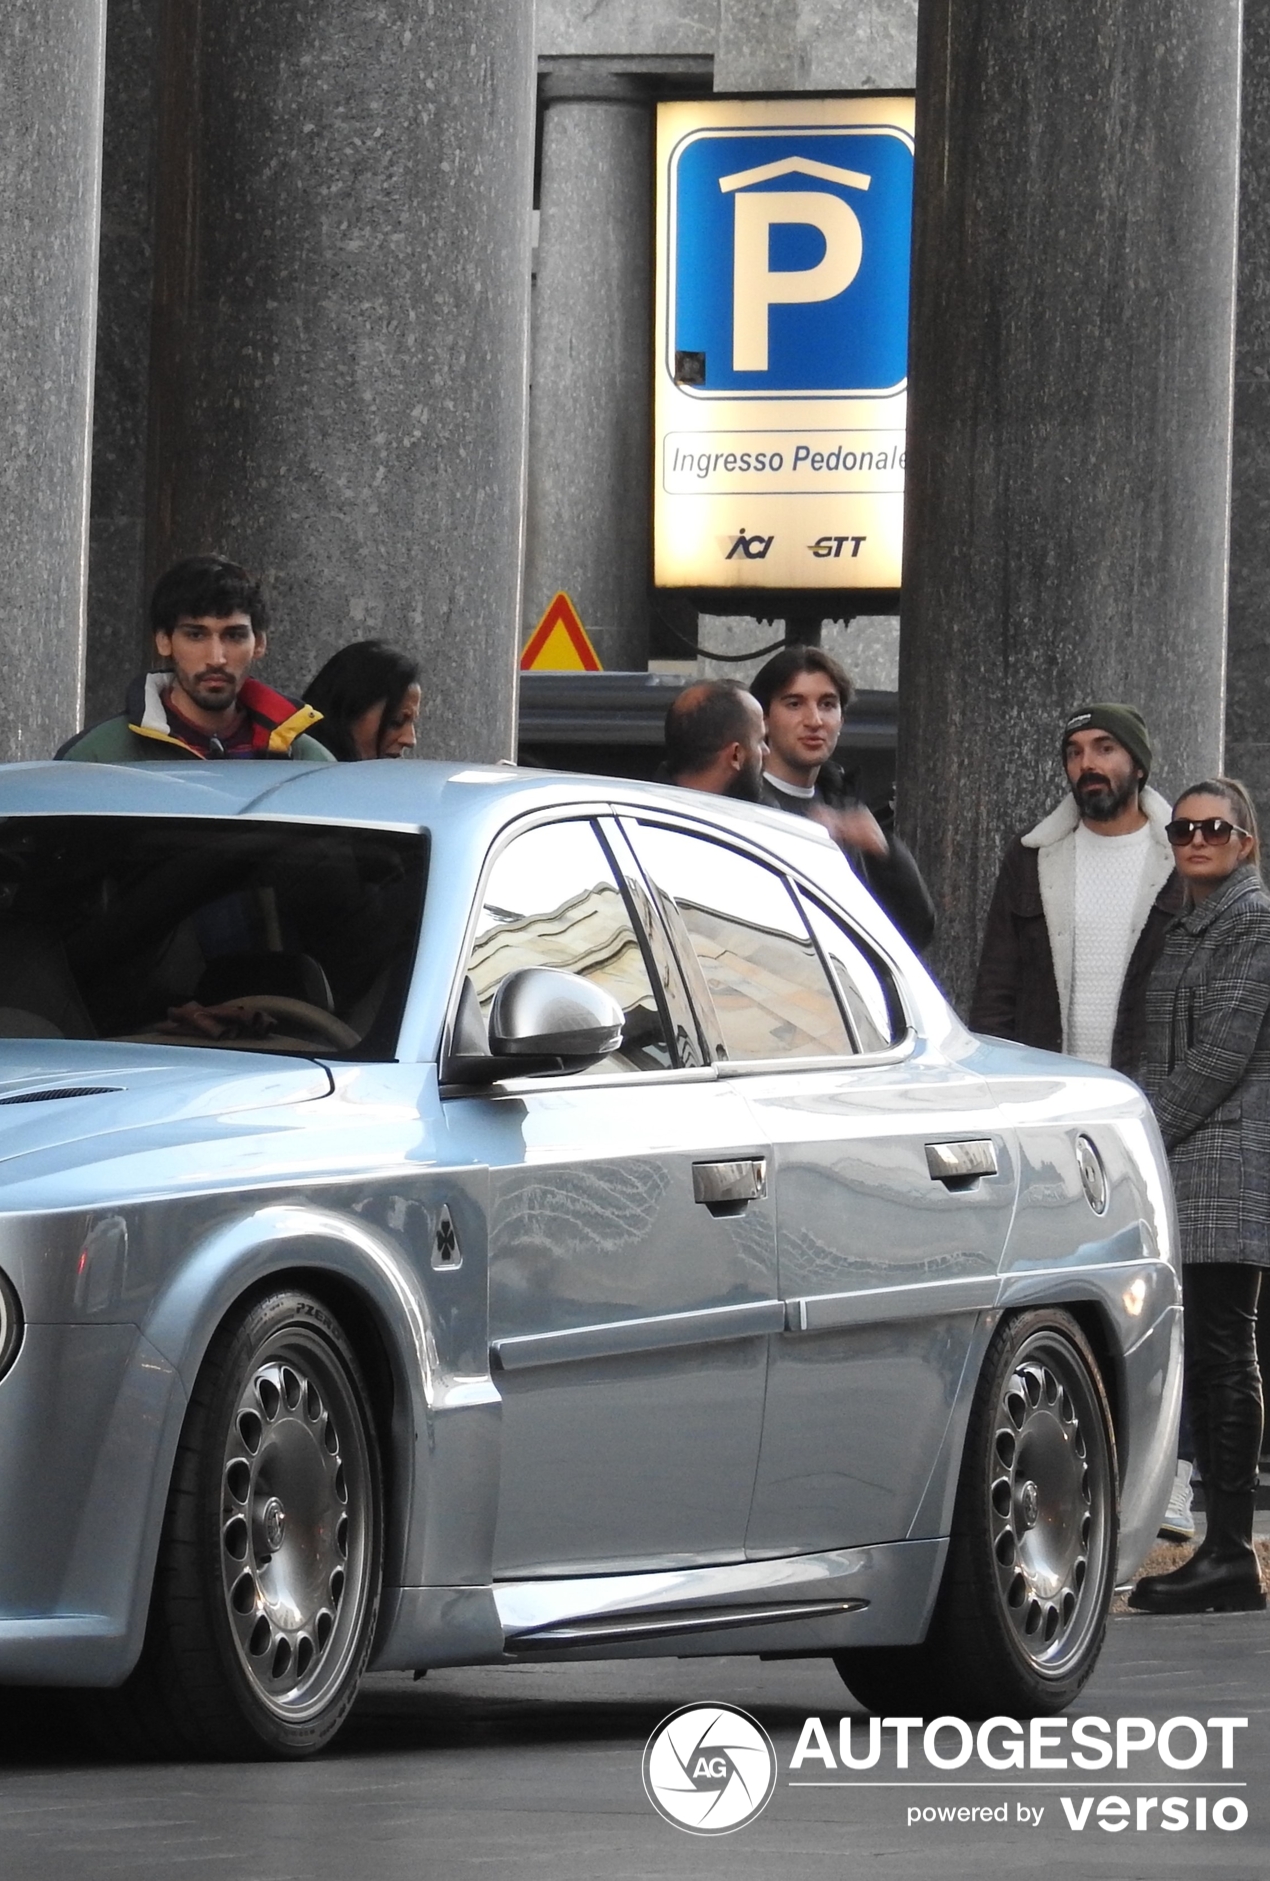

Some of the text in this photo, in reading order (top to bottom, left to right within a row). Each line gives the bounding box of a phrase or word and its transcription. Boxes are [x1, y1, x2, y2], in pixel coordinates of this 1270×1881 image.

[732, 191, 863, 373] P
[672, 447, 784, 479] Ingresso
[807, 536, 867, 558] GTT
